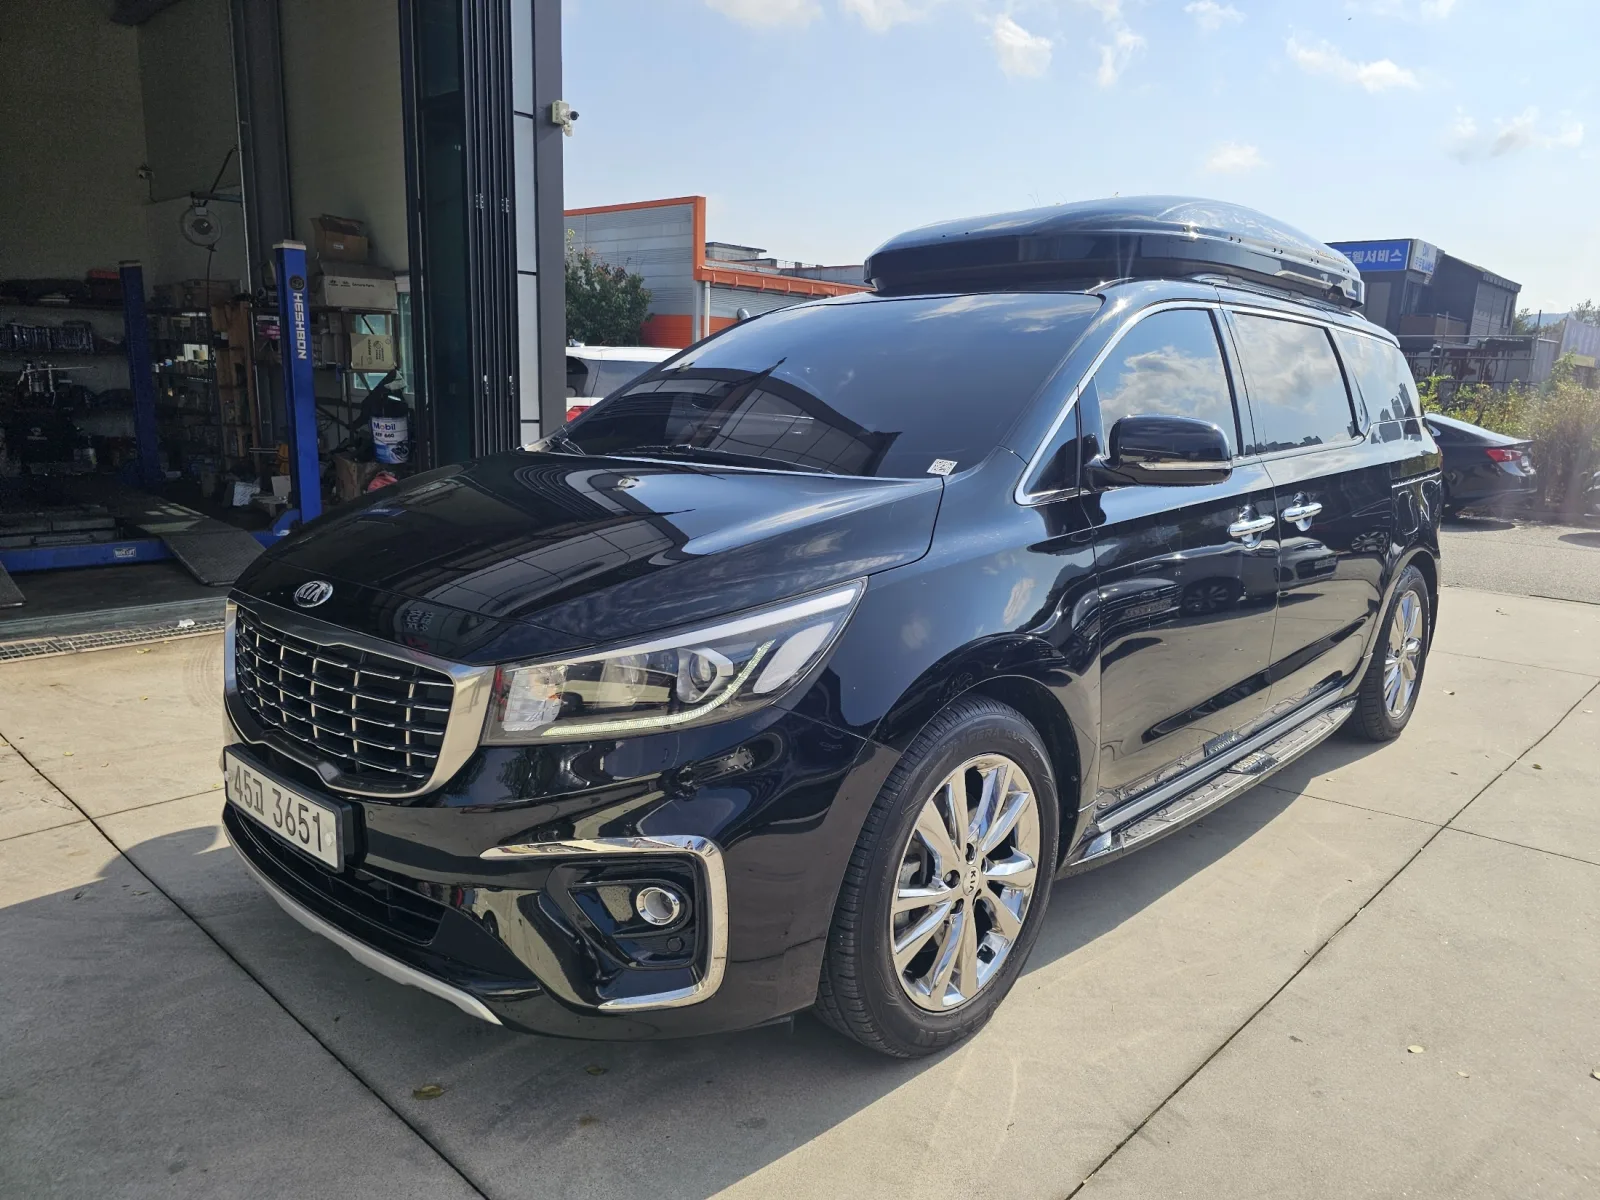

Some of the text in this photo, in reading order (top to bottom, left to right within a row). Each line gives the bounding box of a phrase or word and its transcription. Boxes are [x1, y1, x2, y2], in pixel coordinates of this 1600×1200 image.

[293, 292, 307, 360] HESHBON
[373, 421, 396, 431] Mobil
[234, 765, 322, 853] 45고 3651
